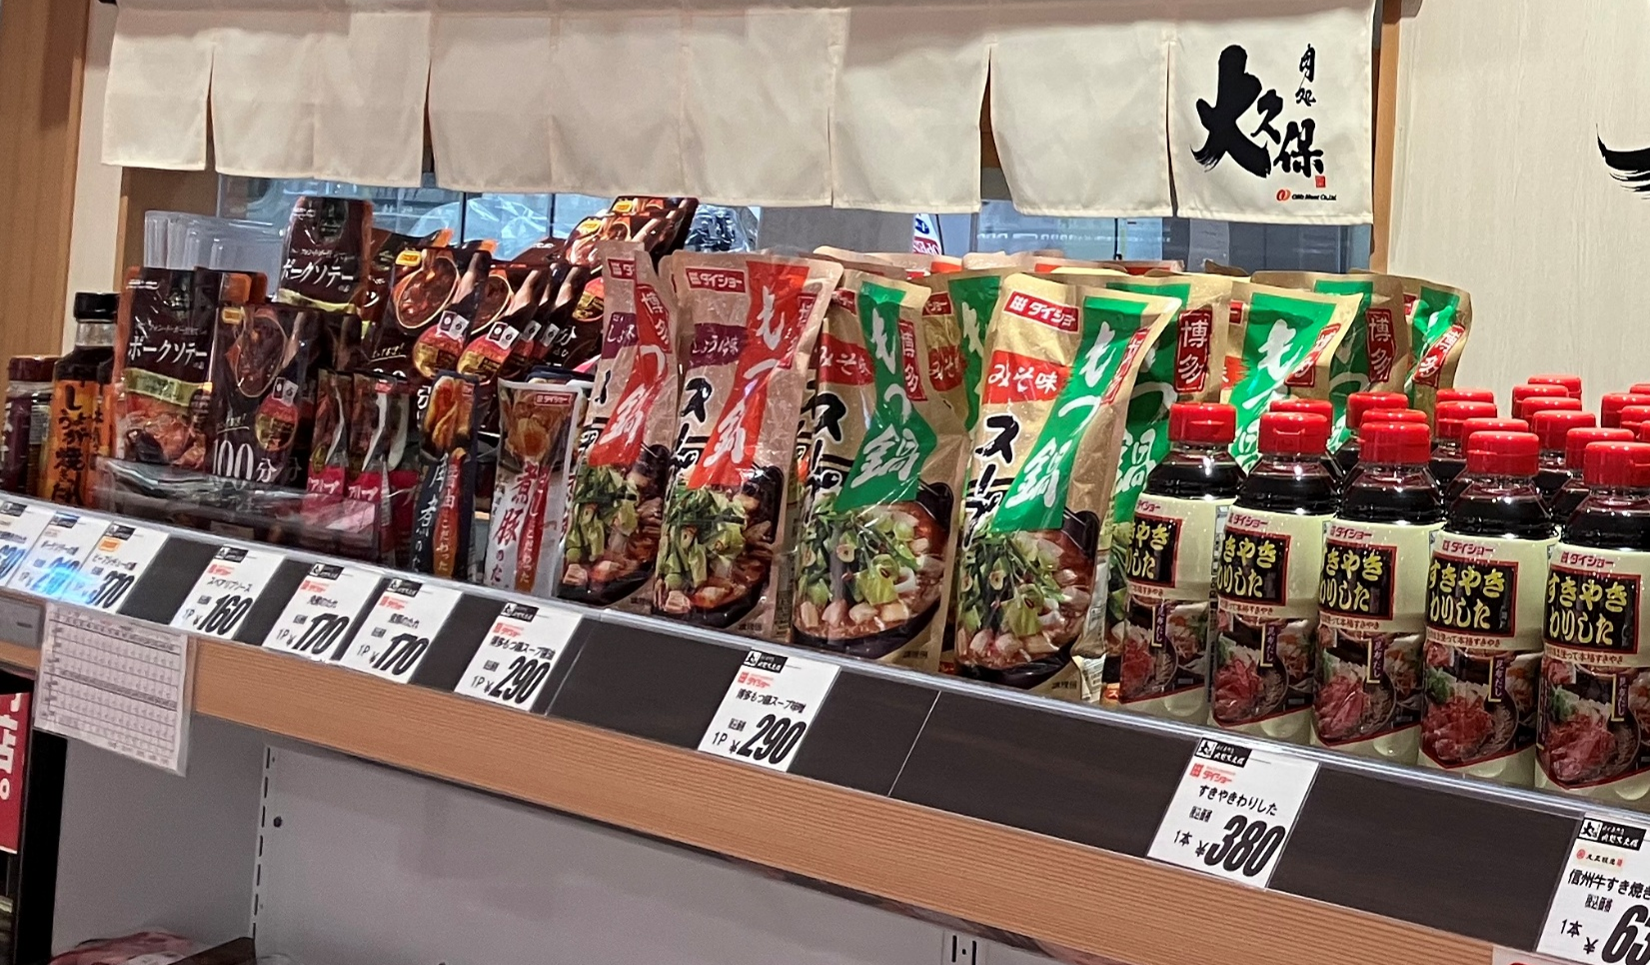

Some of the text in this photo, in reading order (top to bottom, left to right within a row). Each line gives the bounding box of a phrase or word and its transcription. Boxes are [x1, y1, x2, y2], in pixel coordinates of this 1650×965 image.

[1190, 44, 1325, 178] 大久保
[1177, 320, 1209, 385] 博多
[987, 363, 1059, 393] みそ味
[484, 655, 552, 704] ¥290
[711, 713, 807, 765] 1P ¥290
[1198, 784, 1279, 817] すきやきわりした
[1173, 829, 1193, 847] 1本
[1194, 814, 1287, 878] ¥380
[1560, 918, 1583, 939] 1本
